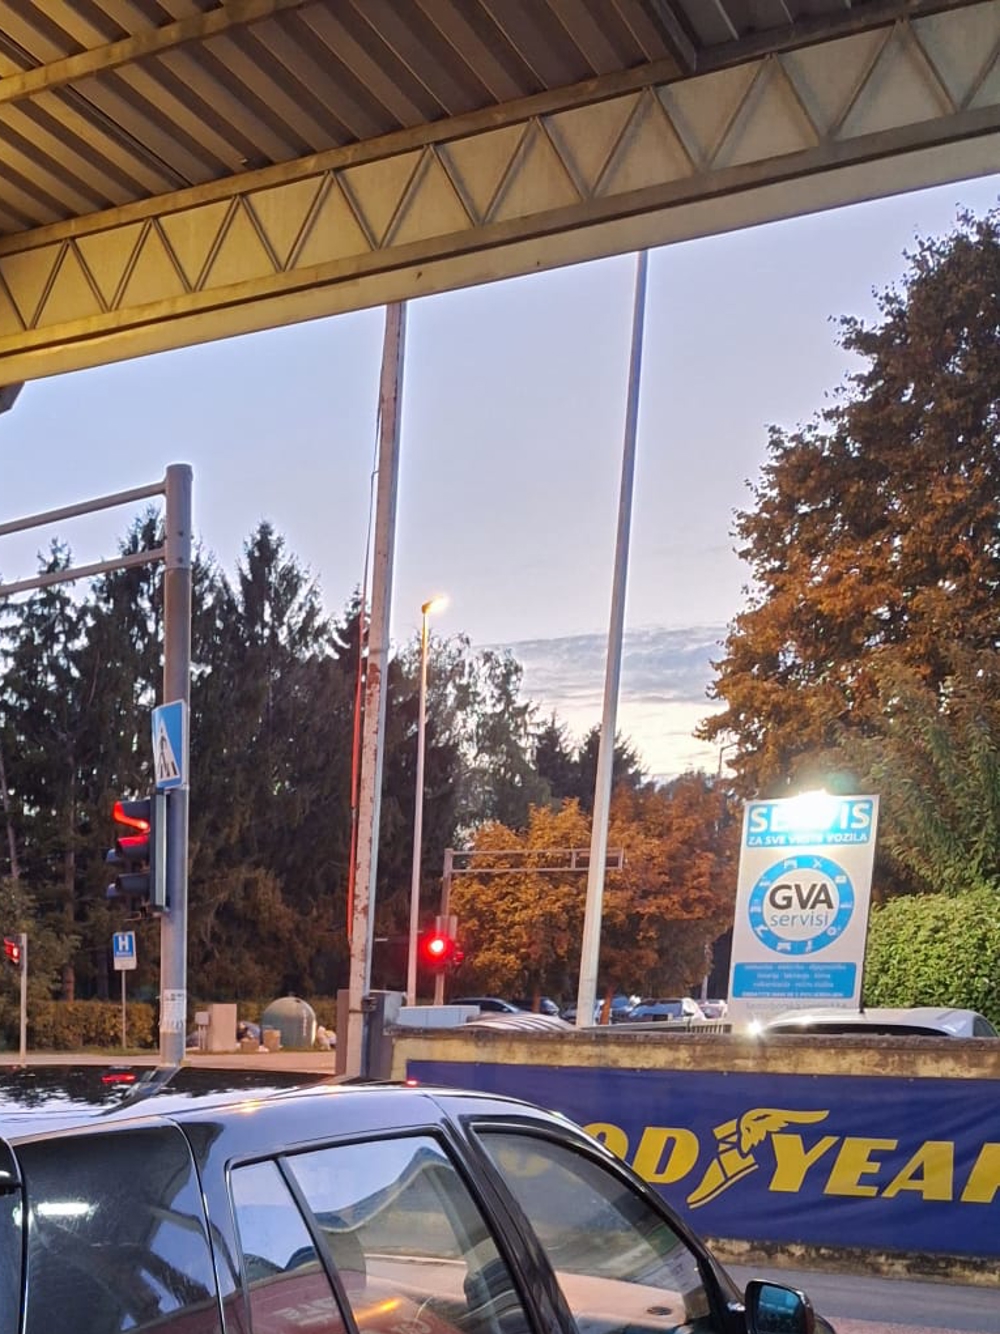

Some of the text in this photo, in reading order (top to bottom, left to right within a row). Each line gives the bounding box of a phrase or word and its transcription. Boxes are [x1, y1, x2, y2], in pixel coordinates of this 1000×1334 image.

[749, 801, 870, 833] SEIS
[768, 883, 834, 911] GVA
[770, 911, 829, 928] servisi
